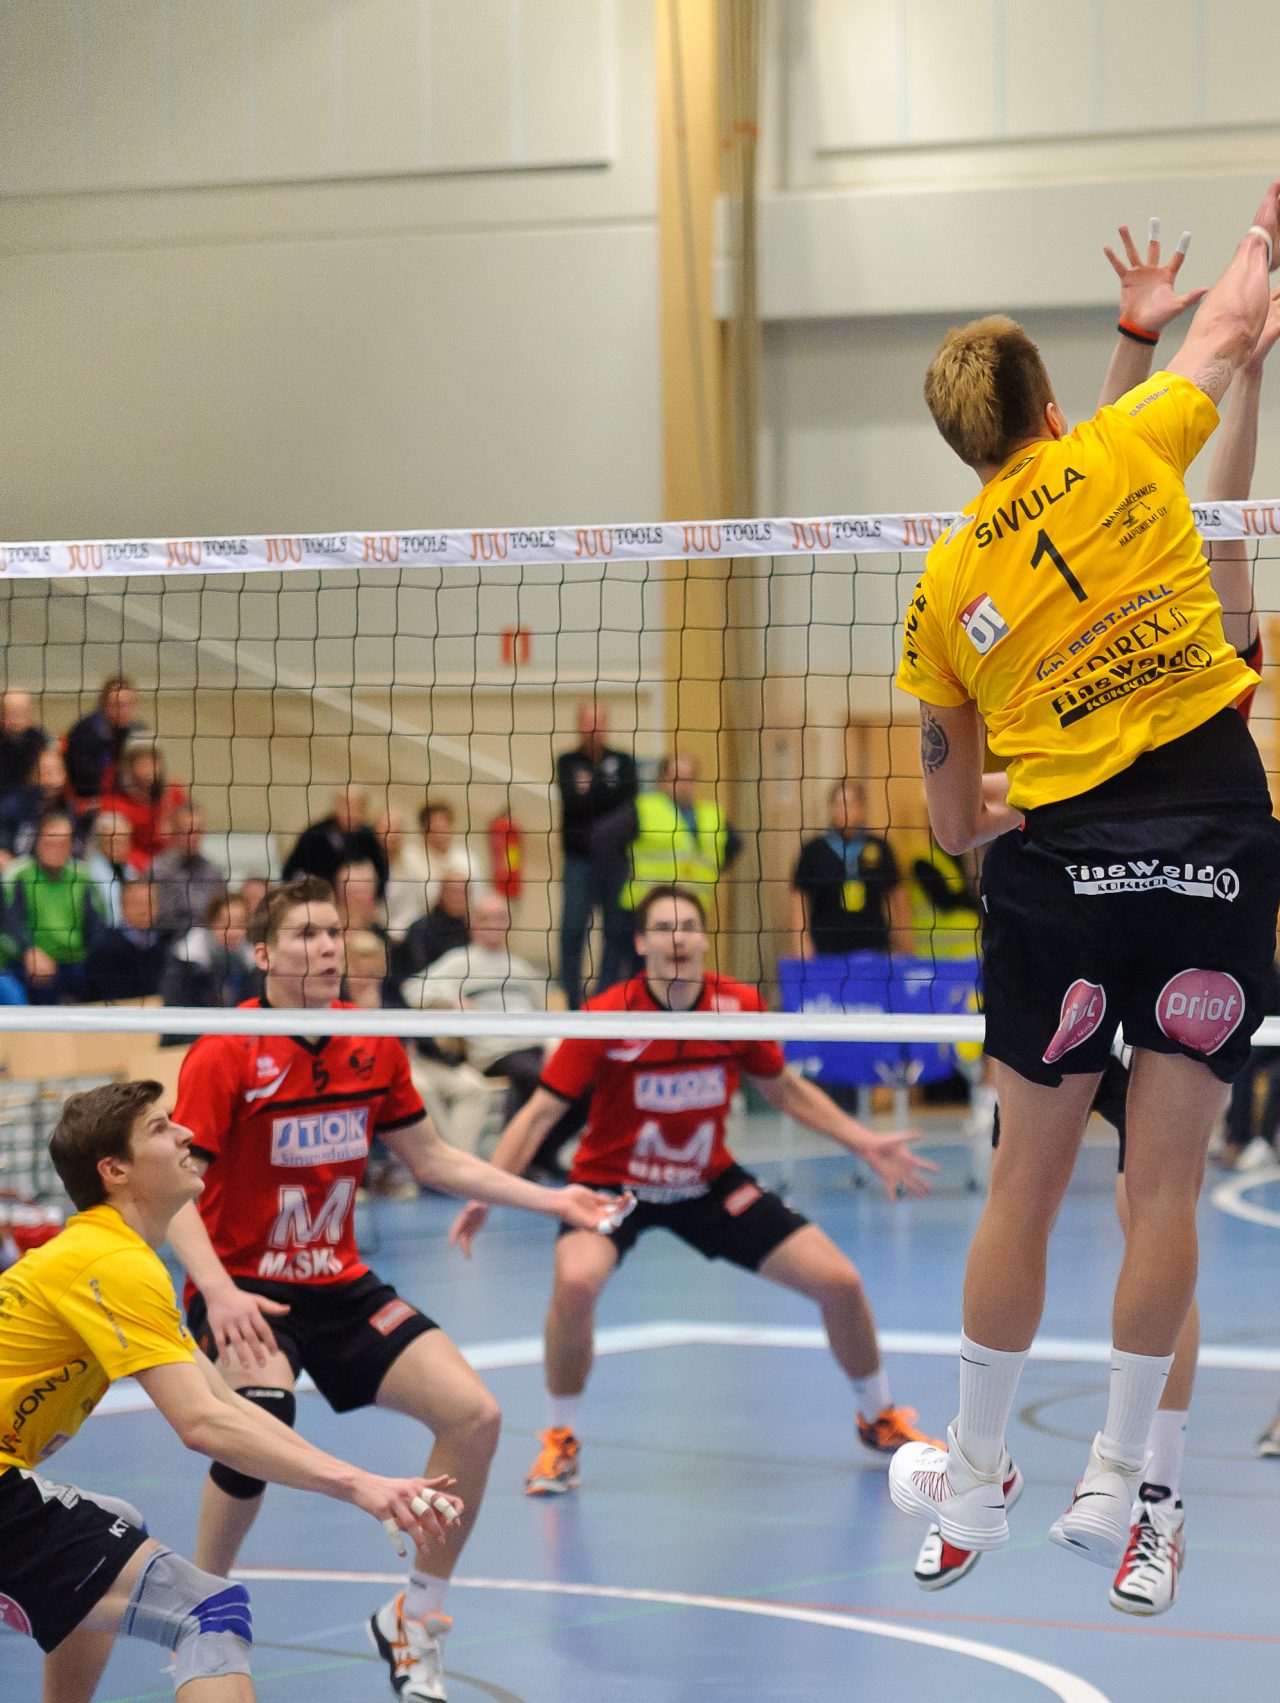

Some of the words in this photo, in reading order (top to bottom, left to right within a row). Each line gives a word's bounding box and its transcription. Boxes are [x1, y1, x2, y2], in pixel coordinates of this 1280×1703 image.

[974, 466, 1087, 549] SIVULA
[1192, 509, 1221, 527] OLS
[362, 535, 400, 563] JUU
[402, 535, 448, 553] TOOLS
[470, 532, 508, 560] JUU
[510, 530, 556, 549] TOOLS
[575, 528, 613, 557] JUU
[615, 526, 663, 545] TOOLS
[682, 525, 722, 552] JUU
[723, 521, 772, 541] TOOLS
[791, 521, 832, 549] JUU
[833, 519, 882, 539] TOOLS
[8, 545, 51, 562] TOOLS
[67, 544, 103, 570] JUU
[104, 543, 150, 560] TOOLS
[166, 541, 200, 567] JUU
[203, 539, 248, 556] TOOLS
[265, 538, 301, 563] JUU
[302, 536, 347, 553] TOOLS
[1029, 528, 1089, 604] 1
[1050, 606, 1189, 691] EDIREX.fi
[311, 1059, 330, 1093] 5
